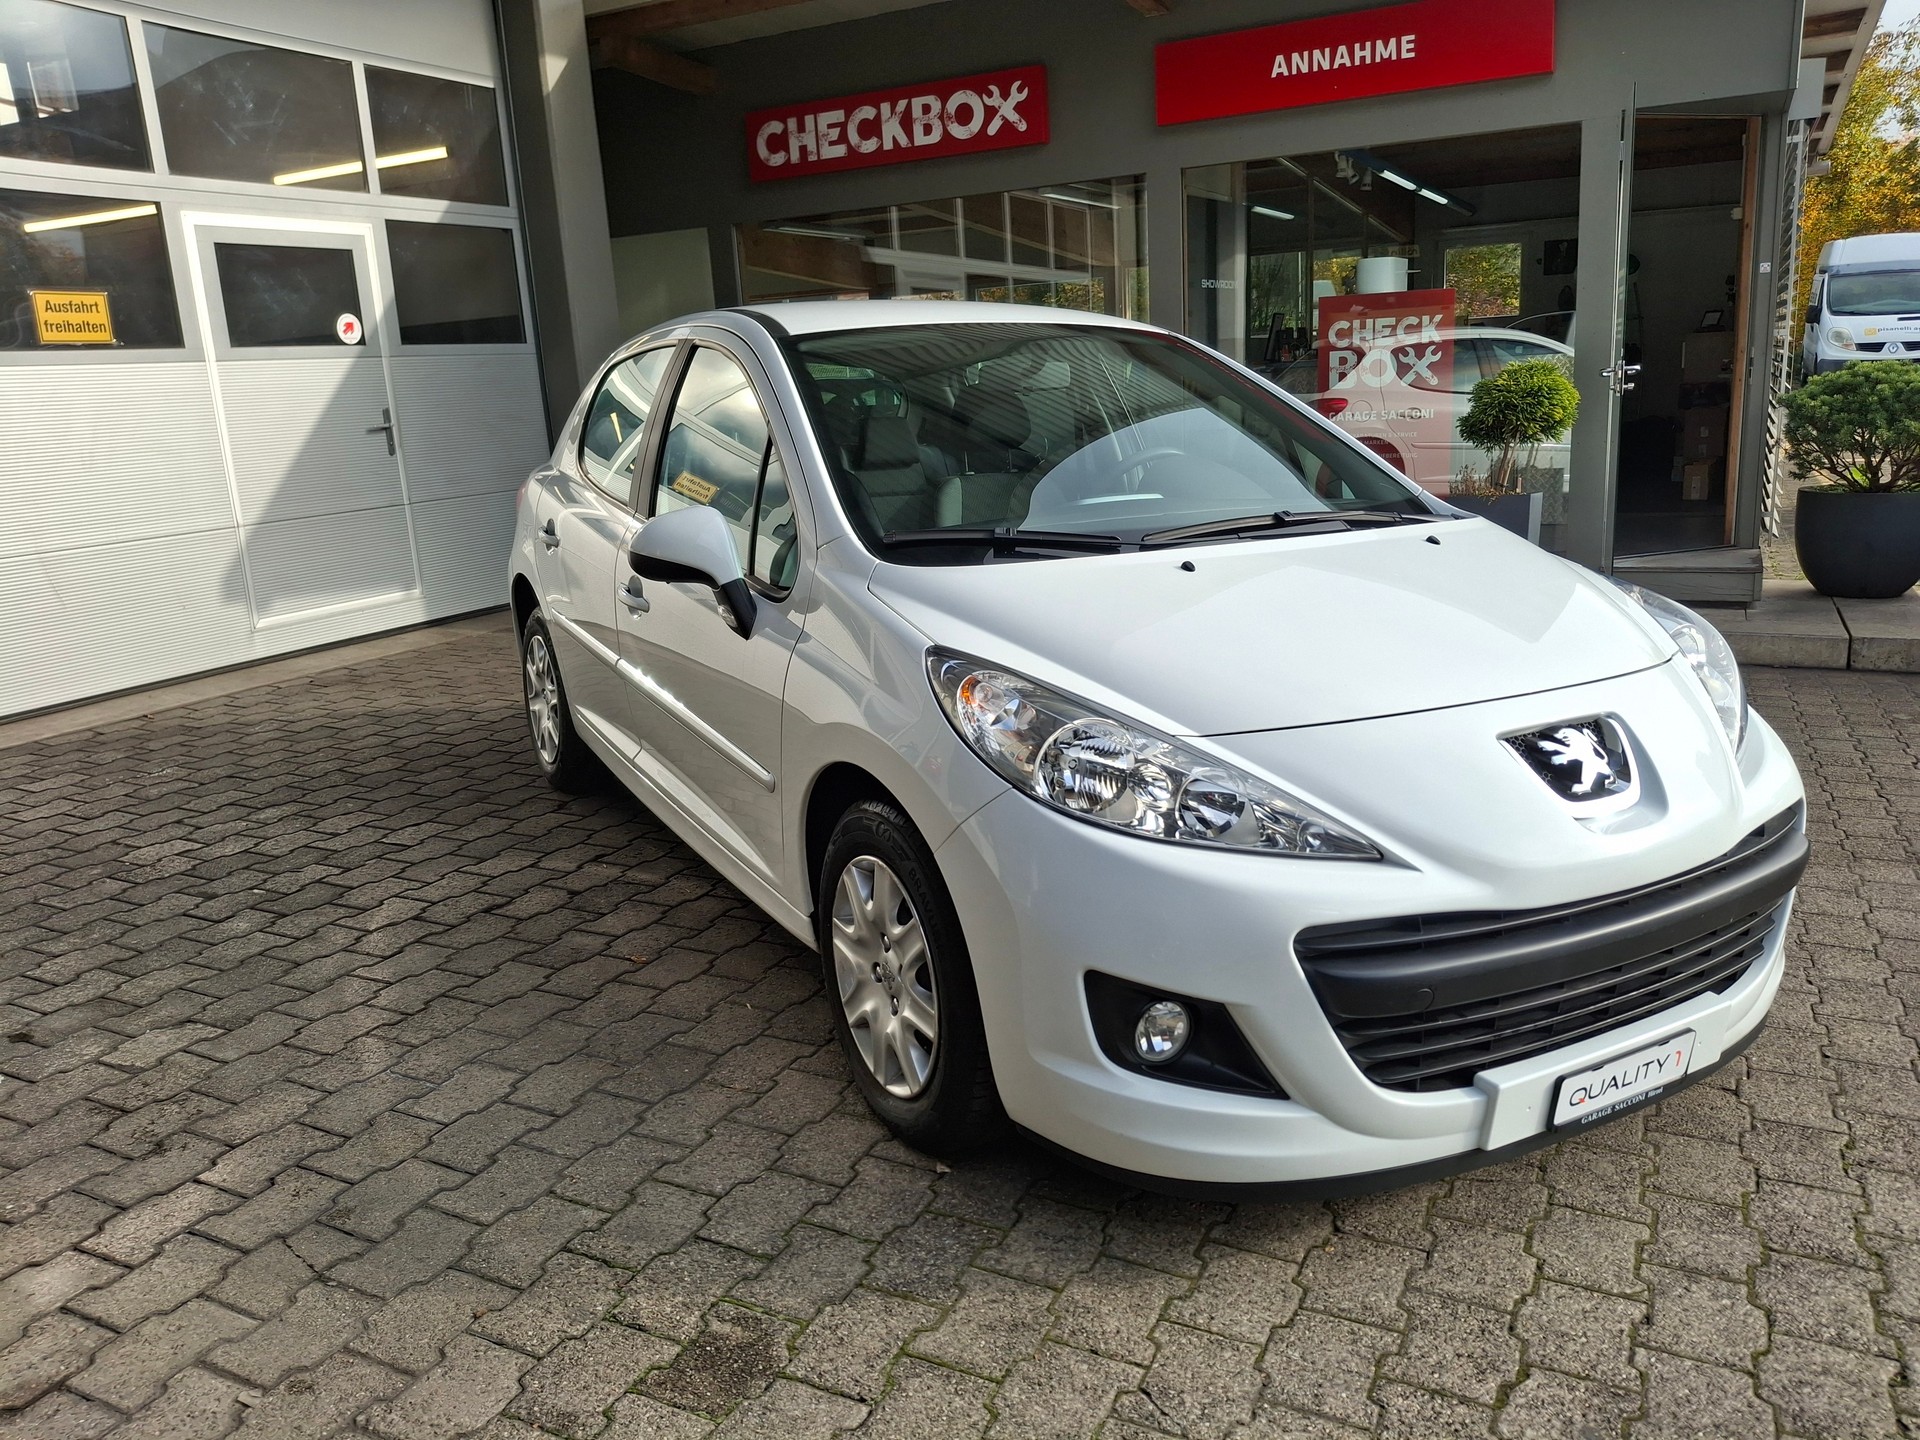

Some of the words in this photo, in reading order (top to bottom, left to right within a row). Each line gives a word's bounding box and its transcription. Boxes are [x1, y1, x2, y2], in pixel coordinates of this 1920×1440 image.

[1270, 34, 1417, 78] ANNAHME
[756, 80, 1030, 168] CHECKBOX
[45, 299, 101, 313] Ausfahrt
[44, 320, 107, 333] freihalten
[1328, 314, 1443, 349] CHECK
[1329, 410, 1377, 422] GARAGE
[1381, 408, 1434, 421] SACCONI
[1569, 1054, 1671, 1106] QUALITY
[1581, 1105, 1613, 1124] GARAGE
[1614, 1092, 1646, 1112] SACCONI
